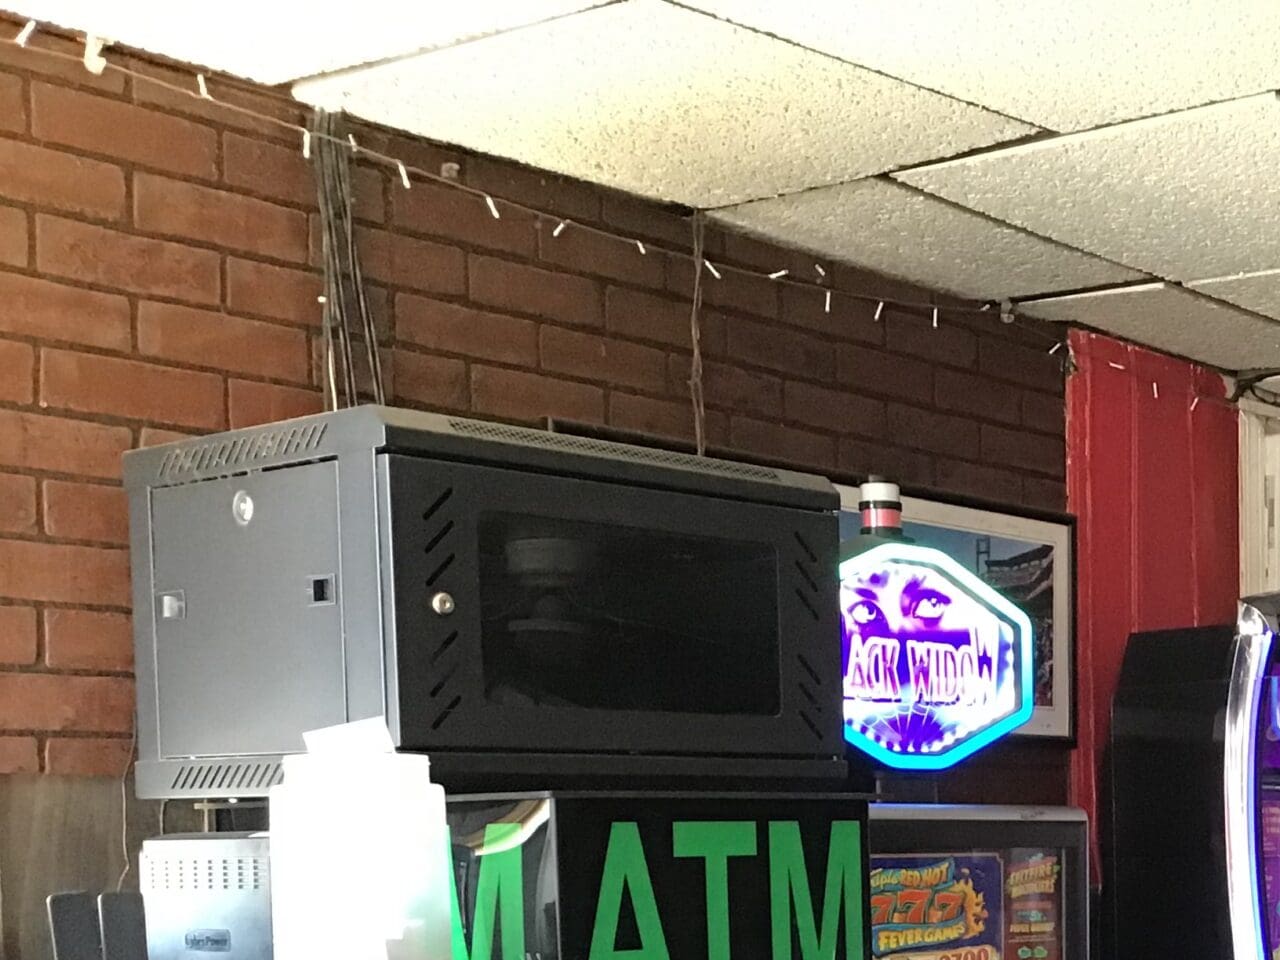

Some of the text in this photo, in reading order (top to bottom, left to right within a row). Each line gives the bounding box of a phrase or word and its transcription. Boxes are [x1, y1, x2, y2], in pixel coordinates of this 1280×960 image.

[843, 622, 998, 708] ACK WIDOW
[900, 868, 922, 886] RED
[923, 862, 949, 886] HOT
[878, 927, 921, 951] FEVER
